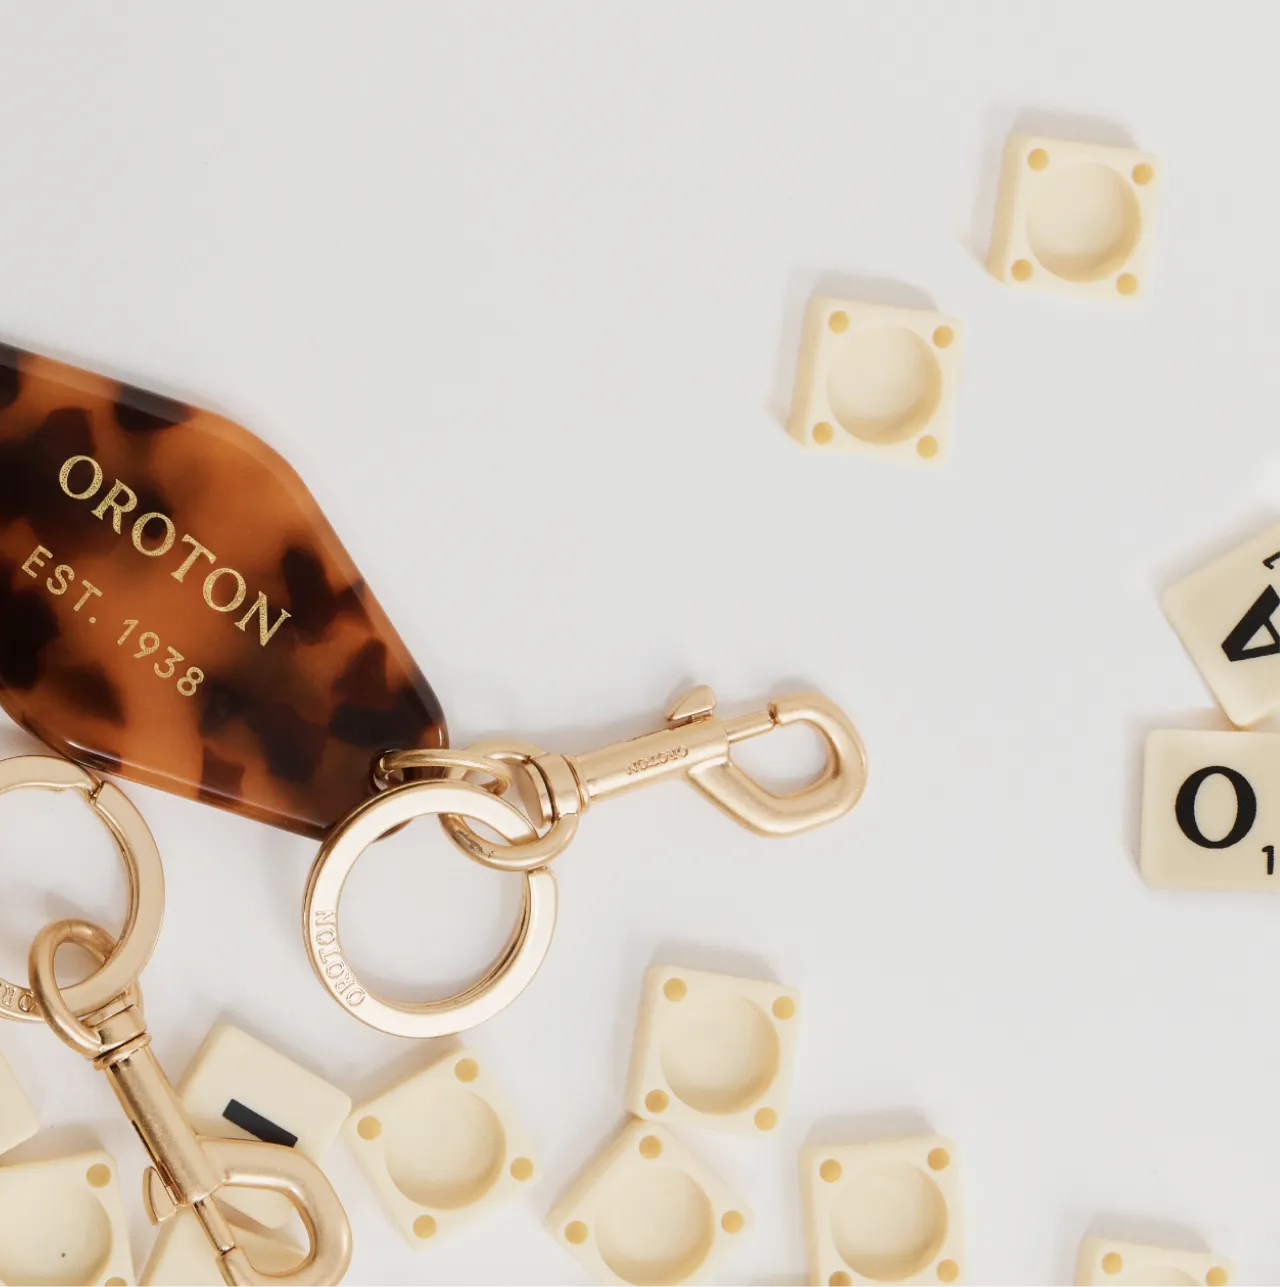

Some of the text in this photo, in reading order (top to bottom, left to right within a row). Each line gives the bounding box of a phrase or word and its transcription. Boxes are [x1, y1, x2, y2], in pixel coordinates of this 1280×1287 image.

[59, 455, 292, 647] OROTON
[21, 545, 205, 697] EST. 1938
[1174, 765, 1275, 876] O 1
[315, 909, 366, 1007] OROTON
